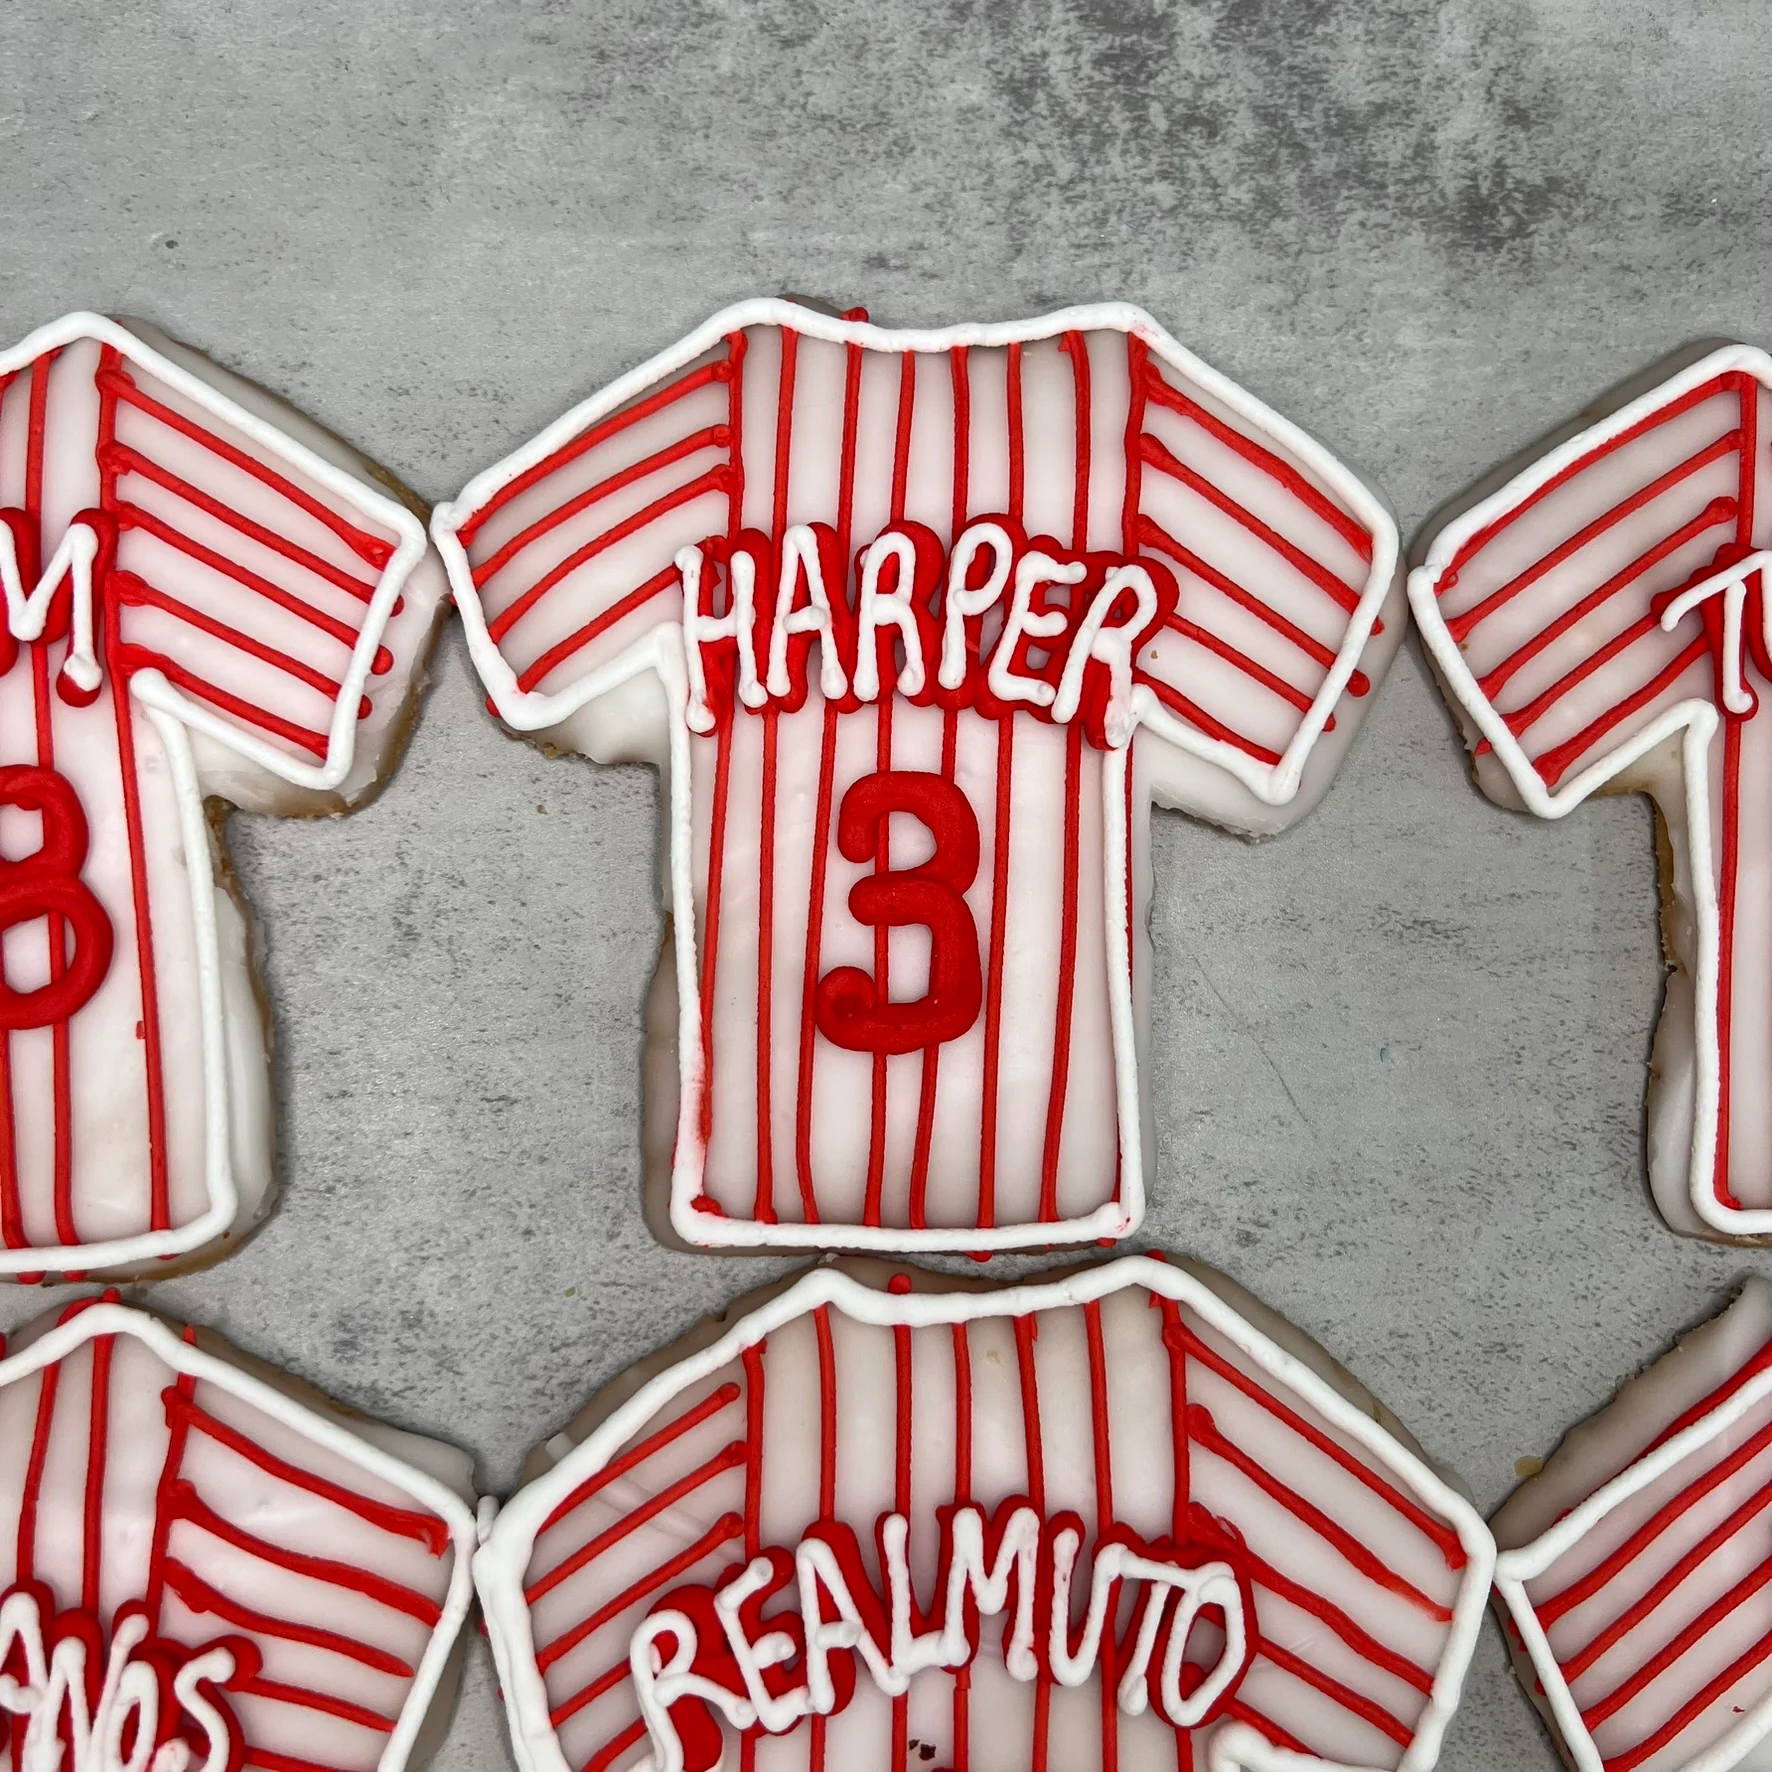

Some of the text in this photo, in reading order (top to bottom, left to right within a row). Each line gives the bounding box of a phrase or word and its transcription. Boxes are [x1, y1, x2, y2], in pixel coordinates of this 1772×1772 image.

[674, 519, 1162, 749] HARPER
[816, 771, 982, 1055] 3
[630, 1505, 1247, 1772] REALMUTO
